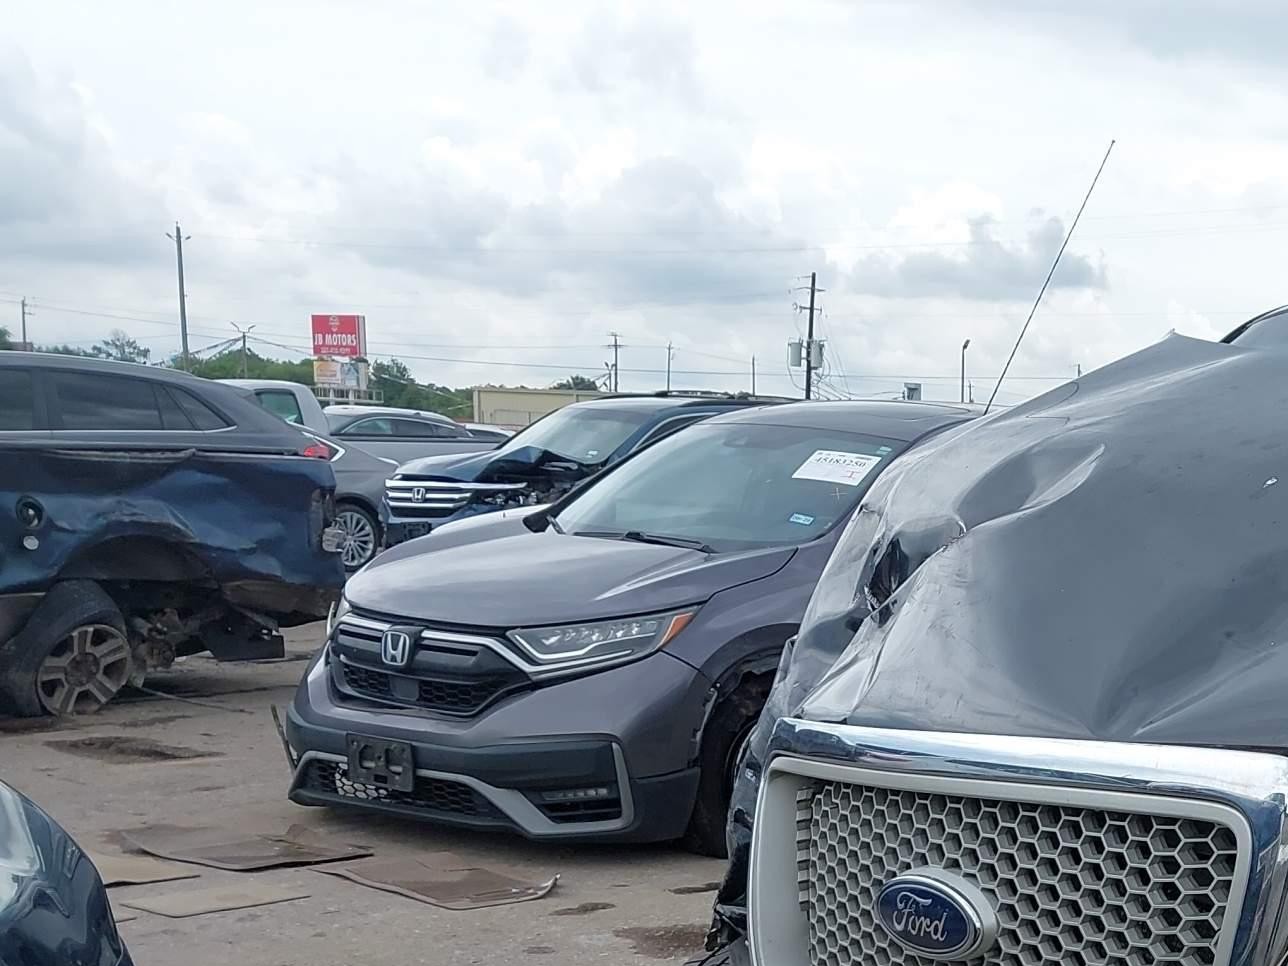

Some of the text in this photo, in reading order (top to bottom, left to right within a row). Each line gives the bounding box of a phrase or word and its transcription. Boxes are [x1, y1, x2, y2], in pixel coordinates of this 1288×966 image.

[314, 333, 356, 346] JB MOTORS
[892, 891, 949, 941] Ford
